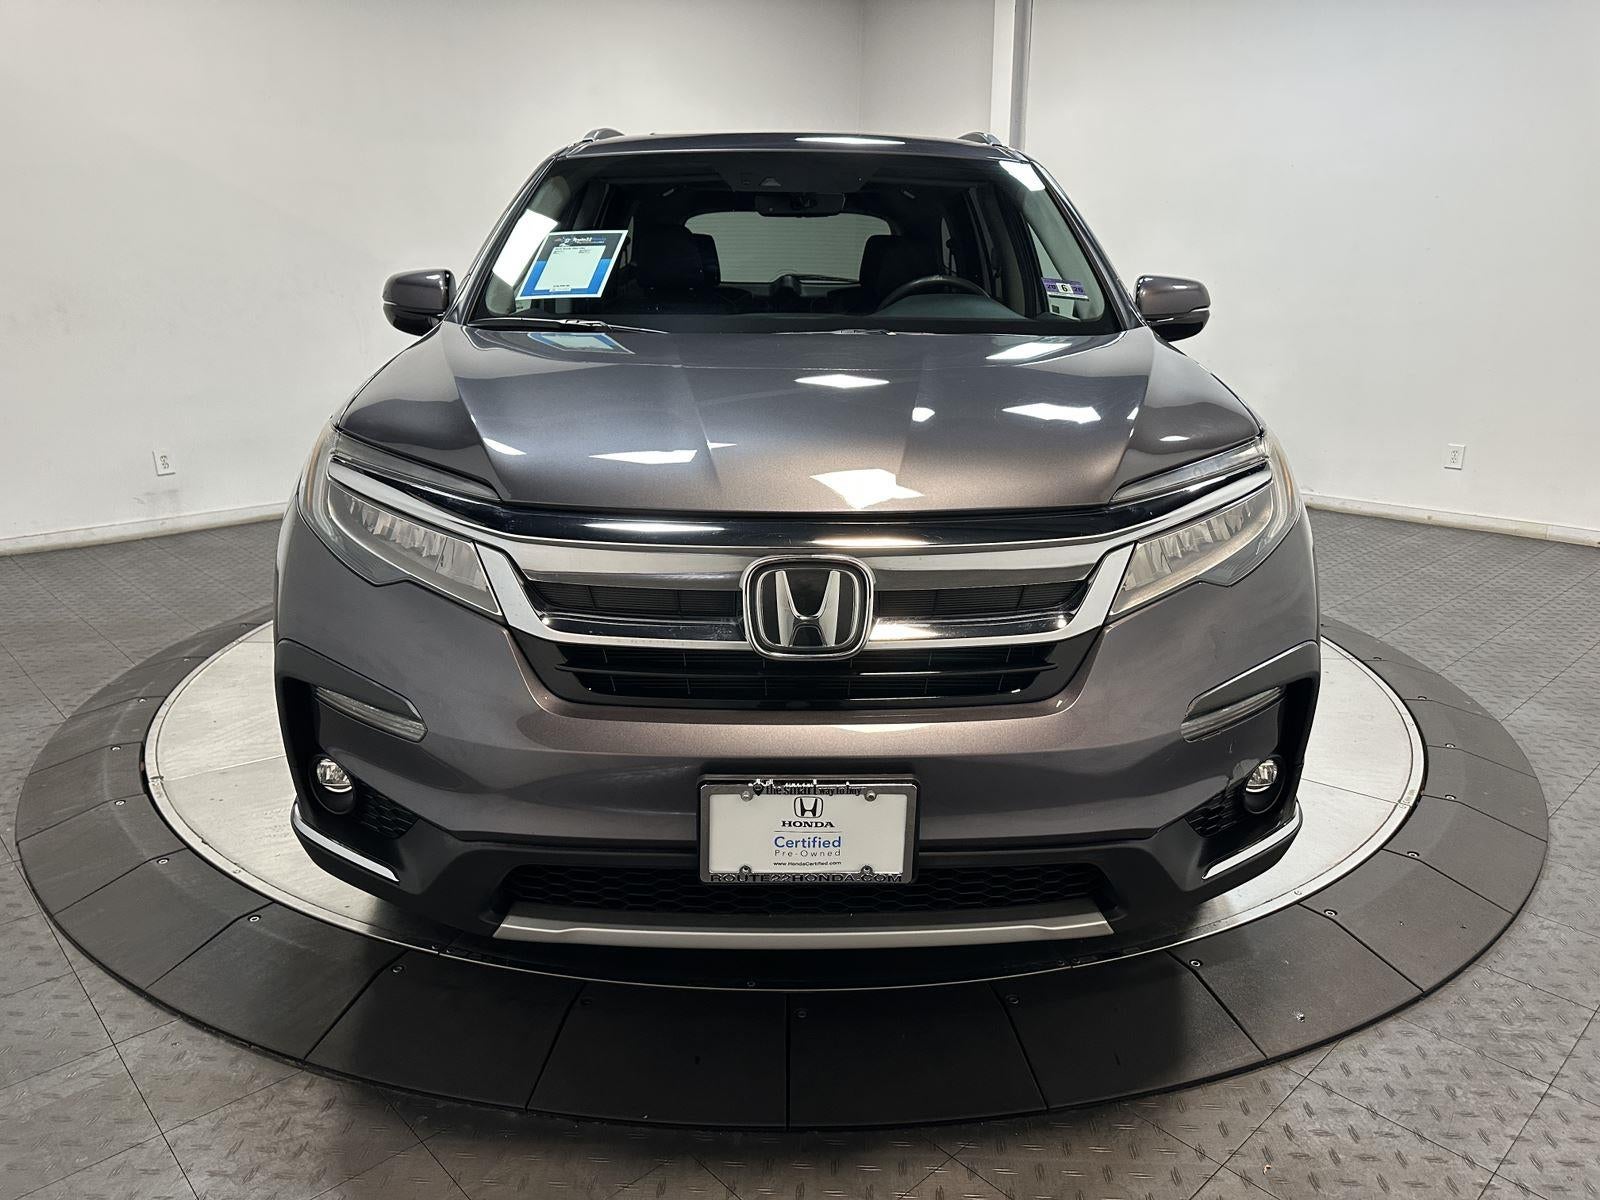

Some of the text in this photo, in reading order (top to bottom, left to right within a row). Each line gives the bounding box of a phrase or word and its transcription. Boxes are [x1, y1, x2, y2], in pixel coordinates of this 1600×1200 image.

[1061, 284, 1068, 292] 6
[766, 781, 862, 796] the smart way to buy
[781, 820, 835, 828] HONDA
[774, 836, 841, 848] Certified
[774, 849, 841, 857] Pre-Owned
